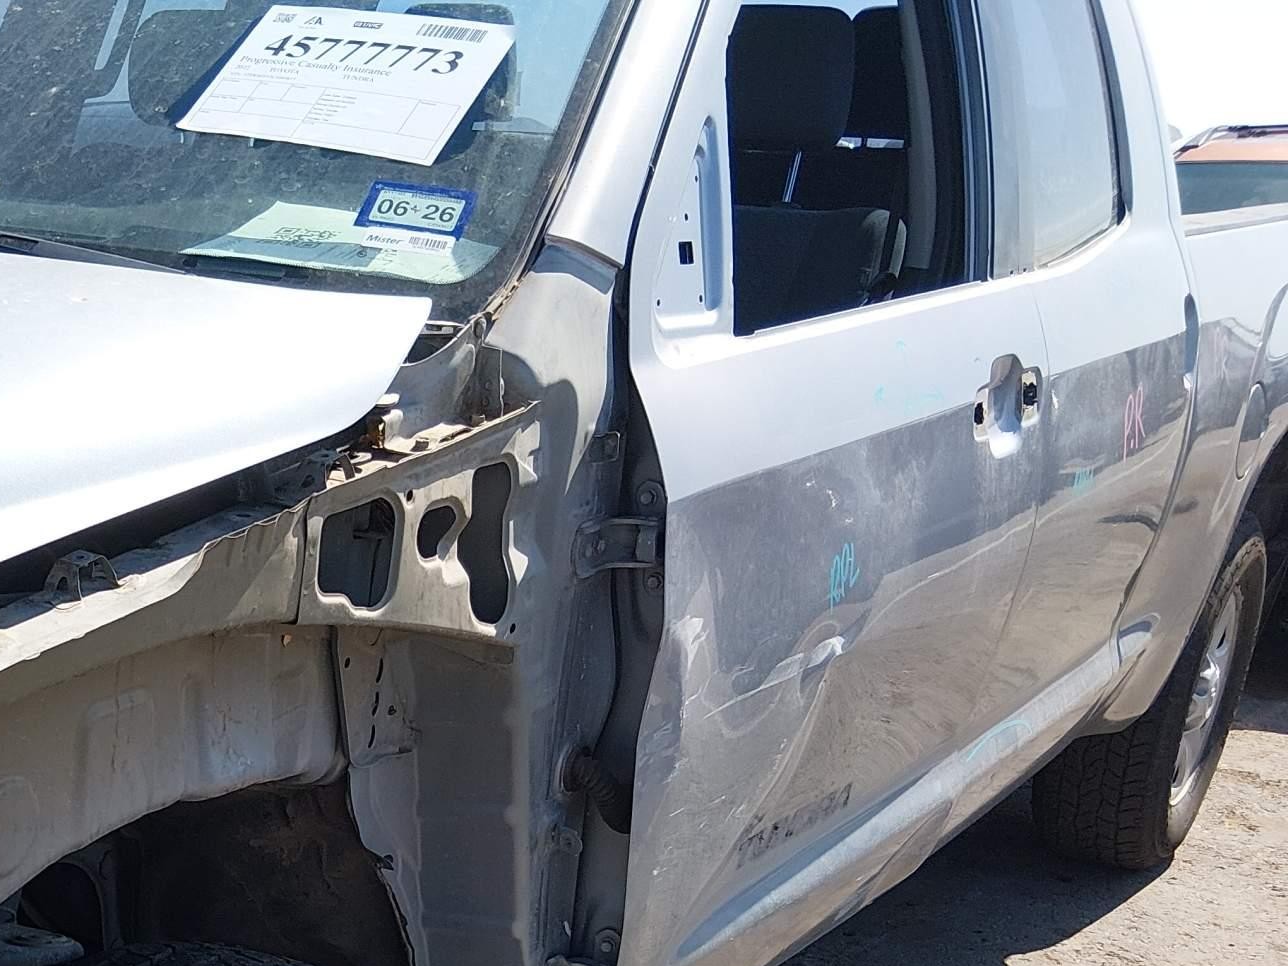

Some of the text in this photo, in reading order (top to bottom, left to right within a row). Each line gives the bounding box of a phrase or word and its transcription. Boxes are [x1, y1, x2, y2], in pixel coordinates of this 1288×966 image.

[240, 55, 393, 77] Progressive Casualty Insurance
[264, 34, 464, 75] 45777773
[376, 199, 457, 223] 06 26
[366, 234, 403, 245] Mister
